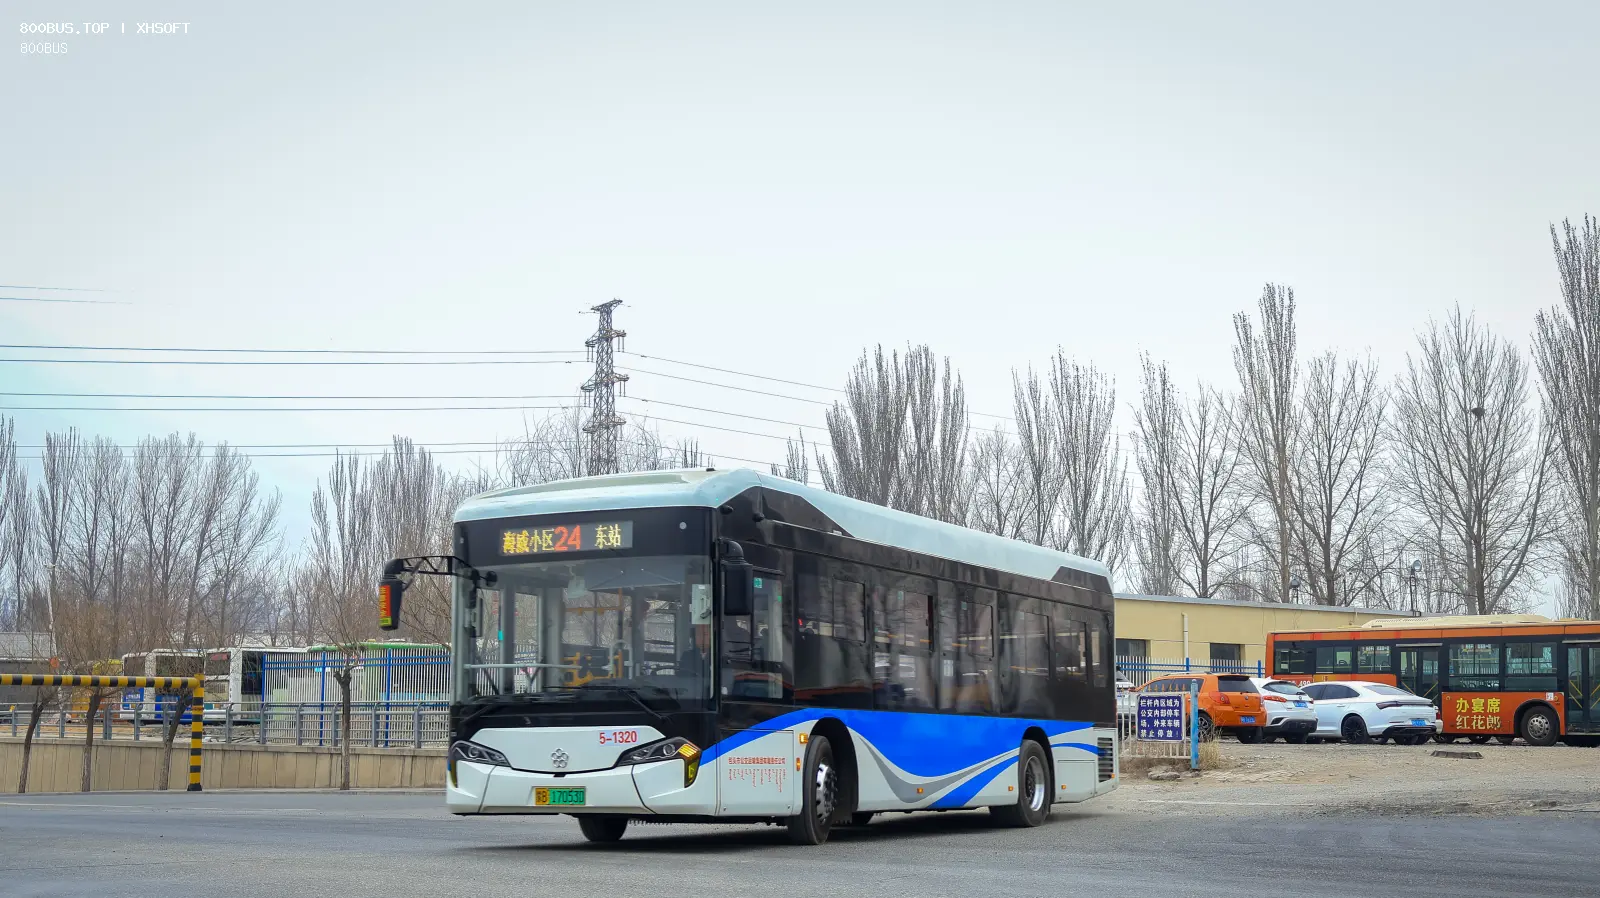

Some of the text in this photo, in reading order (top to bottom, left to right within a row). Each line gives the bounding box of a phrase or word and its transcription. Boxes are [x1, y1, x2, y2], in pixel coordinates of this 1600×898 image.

[554, 525, 582, 551] 24
[594, 523, 622, 550] 东站
[1140, 699, 1180, 708] 栏杆内区域为
[1455, 697, 1501, 714] 办宴席
[1140, 709, 1180, 718] 公交内部停车
[1455, 714, 1501, 731] 红花郎
[599, 730, 638, 745] 5-1320
